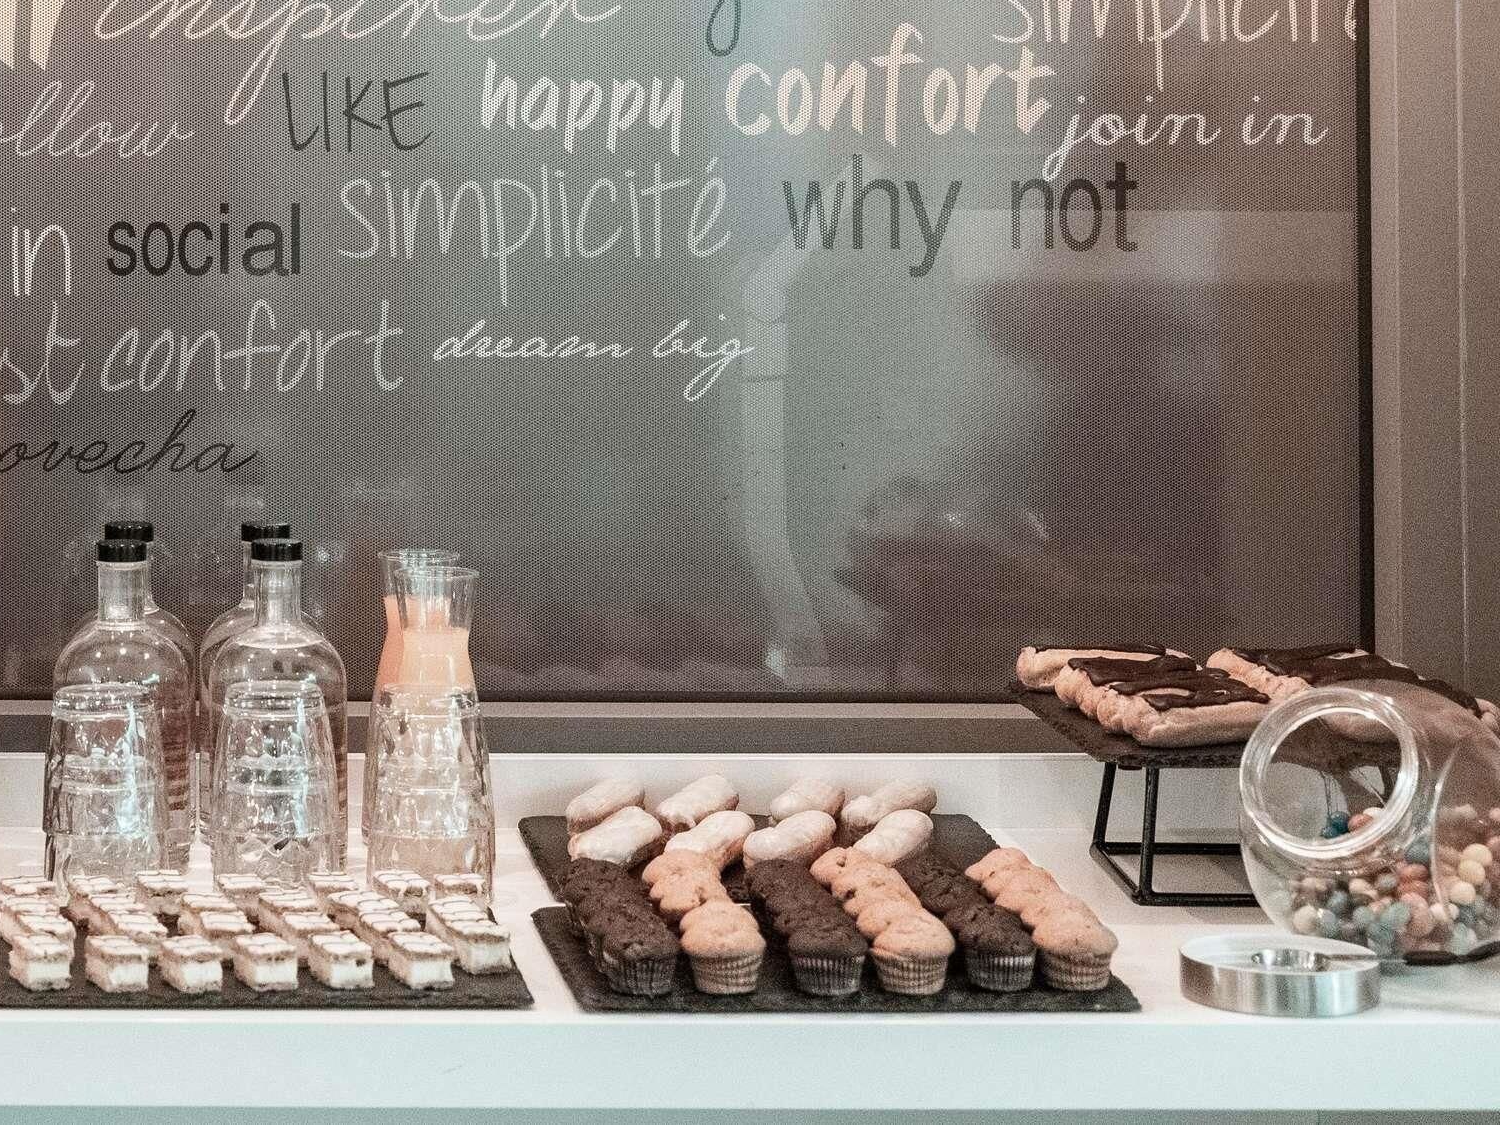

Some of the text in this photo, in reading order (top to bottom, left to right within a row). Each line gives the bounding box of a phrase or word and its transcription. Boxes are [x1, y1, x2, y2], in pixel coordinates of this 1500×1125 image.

[479, 59, 684, 156] happy
[724, 23, 1056, 147] confort
[1042, 94, 1329, 180] join in
[9, 206, 72, 297] in
[106, 203, 301, 277] social
[338, 157, 731, 307] simplicité
[781, 153, 1138, 278] why not
[100, 299, 403, 393] confort
[432, 312, 755, 402] dream big
